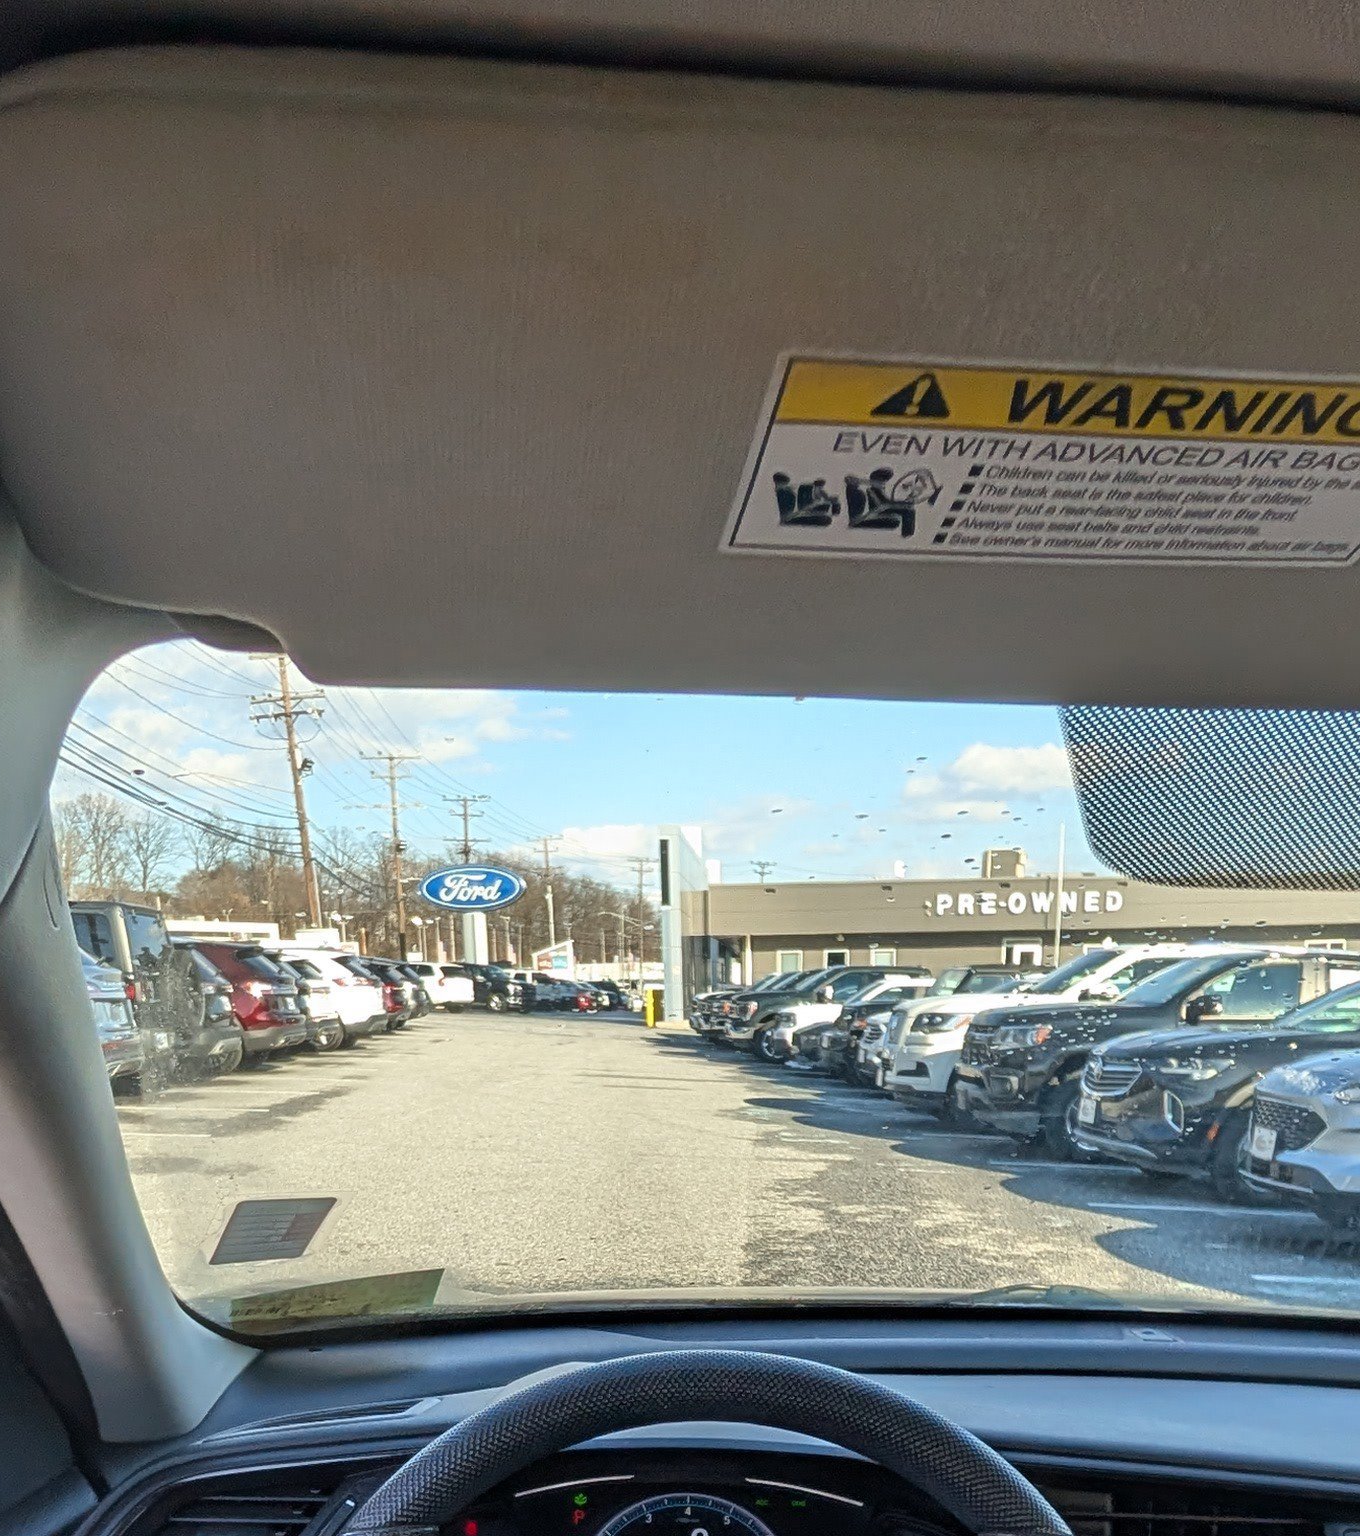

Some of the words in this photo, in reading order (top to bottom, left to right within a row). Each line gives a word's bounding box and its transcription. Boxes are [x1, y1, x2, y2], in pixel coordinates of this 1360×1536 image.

[833, 432, 932, 456] EVEN
[942, 435, 1032, 459] WITH
[1033, 439, 1226, 468] ADVANCED
[1227, 448, 1288, 470] AIR
[986, 465, 1053, 481] Children
[1056, 471, 1087, 483] can
[1089, 470, 1111, 483] be
[1112, 470, 1158, 484] killed
[1175, 474, 1243, 489] seriously
[1246, 475, 1300, 490] injured
[1302, 476, 1323, 490] by
[1324, 477, 1351, 490] the
[979, 483, 1008, 497] The
[1010, 484, 1047, 498] back
[1051, 487, 1088, 499] seat
[1106, 488, 1132, 500] the
[1227, 491, 1249, 504] for
[967, 502, 1015, 515] Never
[1015, 503, 1044, 517] put
[1233, 508, 1261, 520] the
[958, 516, 1013, 531] Always
[1015, 521, 1045, 531] use
[1121, 522, 1154, 534] and
[949, 532, 981, 545] See
[1044, 536, 1102, 549] manual
[1124, 538, 1164, 550] more
[440, 873, 502, 902] Ford
[936, 890, 1124, 916] PRE-OWNED
[645, 1514, 652, 1523] 3
